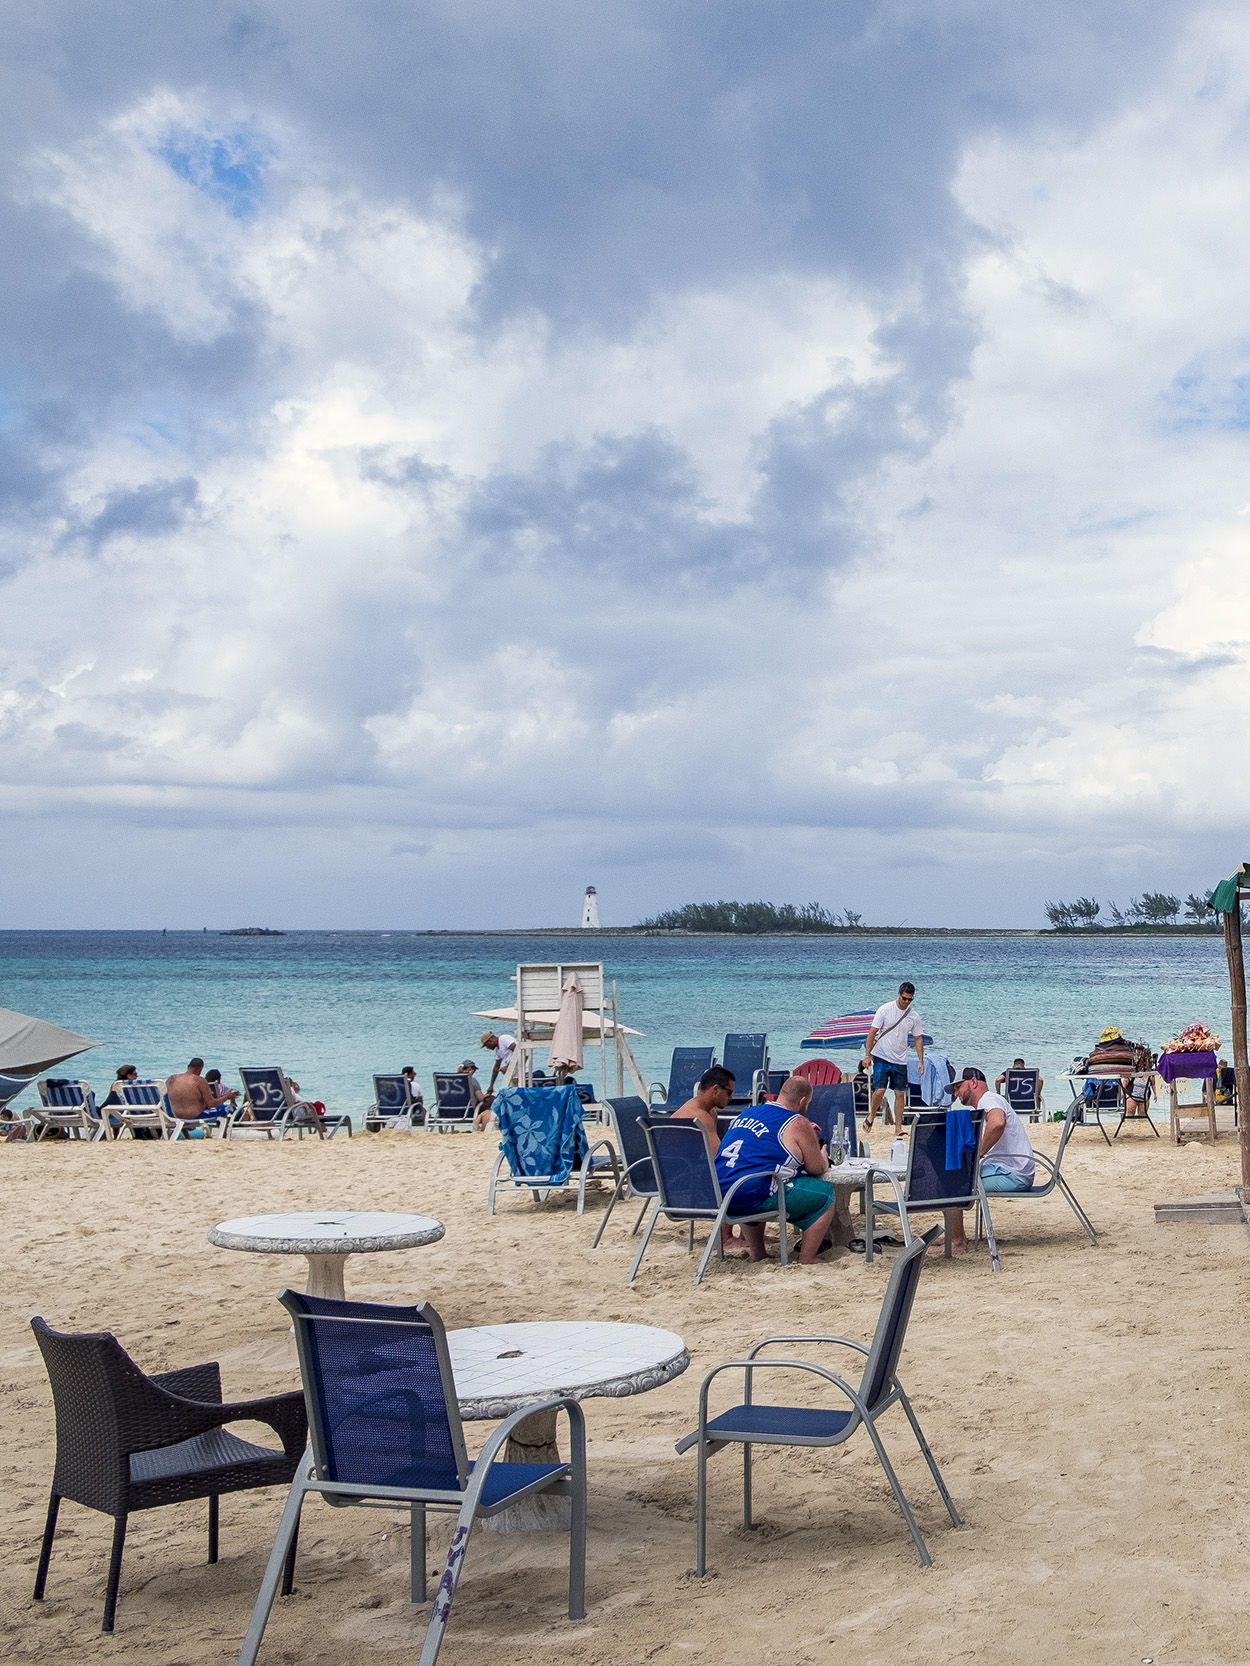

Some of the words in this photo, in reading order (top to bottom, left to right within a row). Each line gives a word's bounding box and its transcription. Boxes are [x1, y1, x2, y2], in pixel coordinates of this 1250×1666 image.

[437, 1078, 466, 1096] JS
[1009, 1076, 1034, 1096] JS
[721, 1139, 744, 1169] 4
